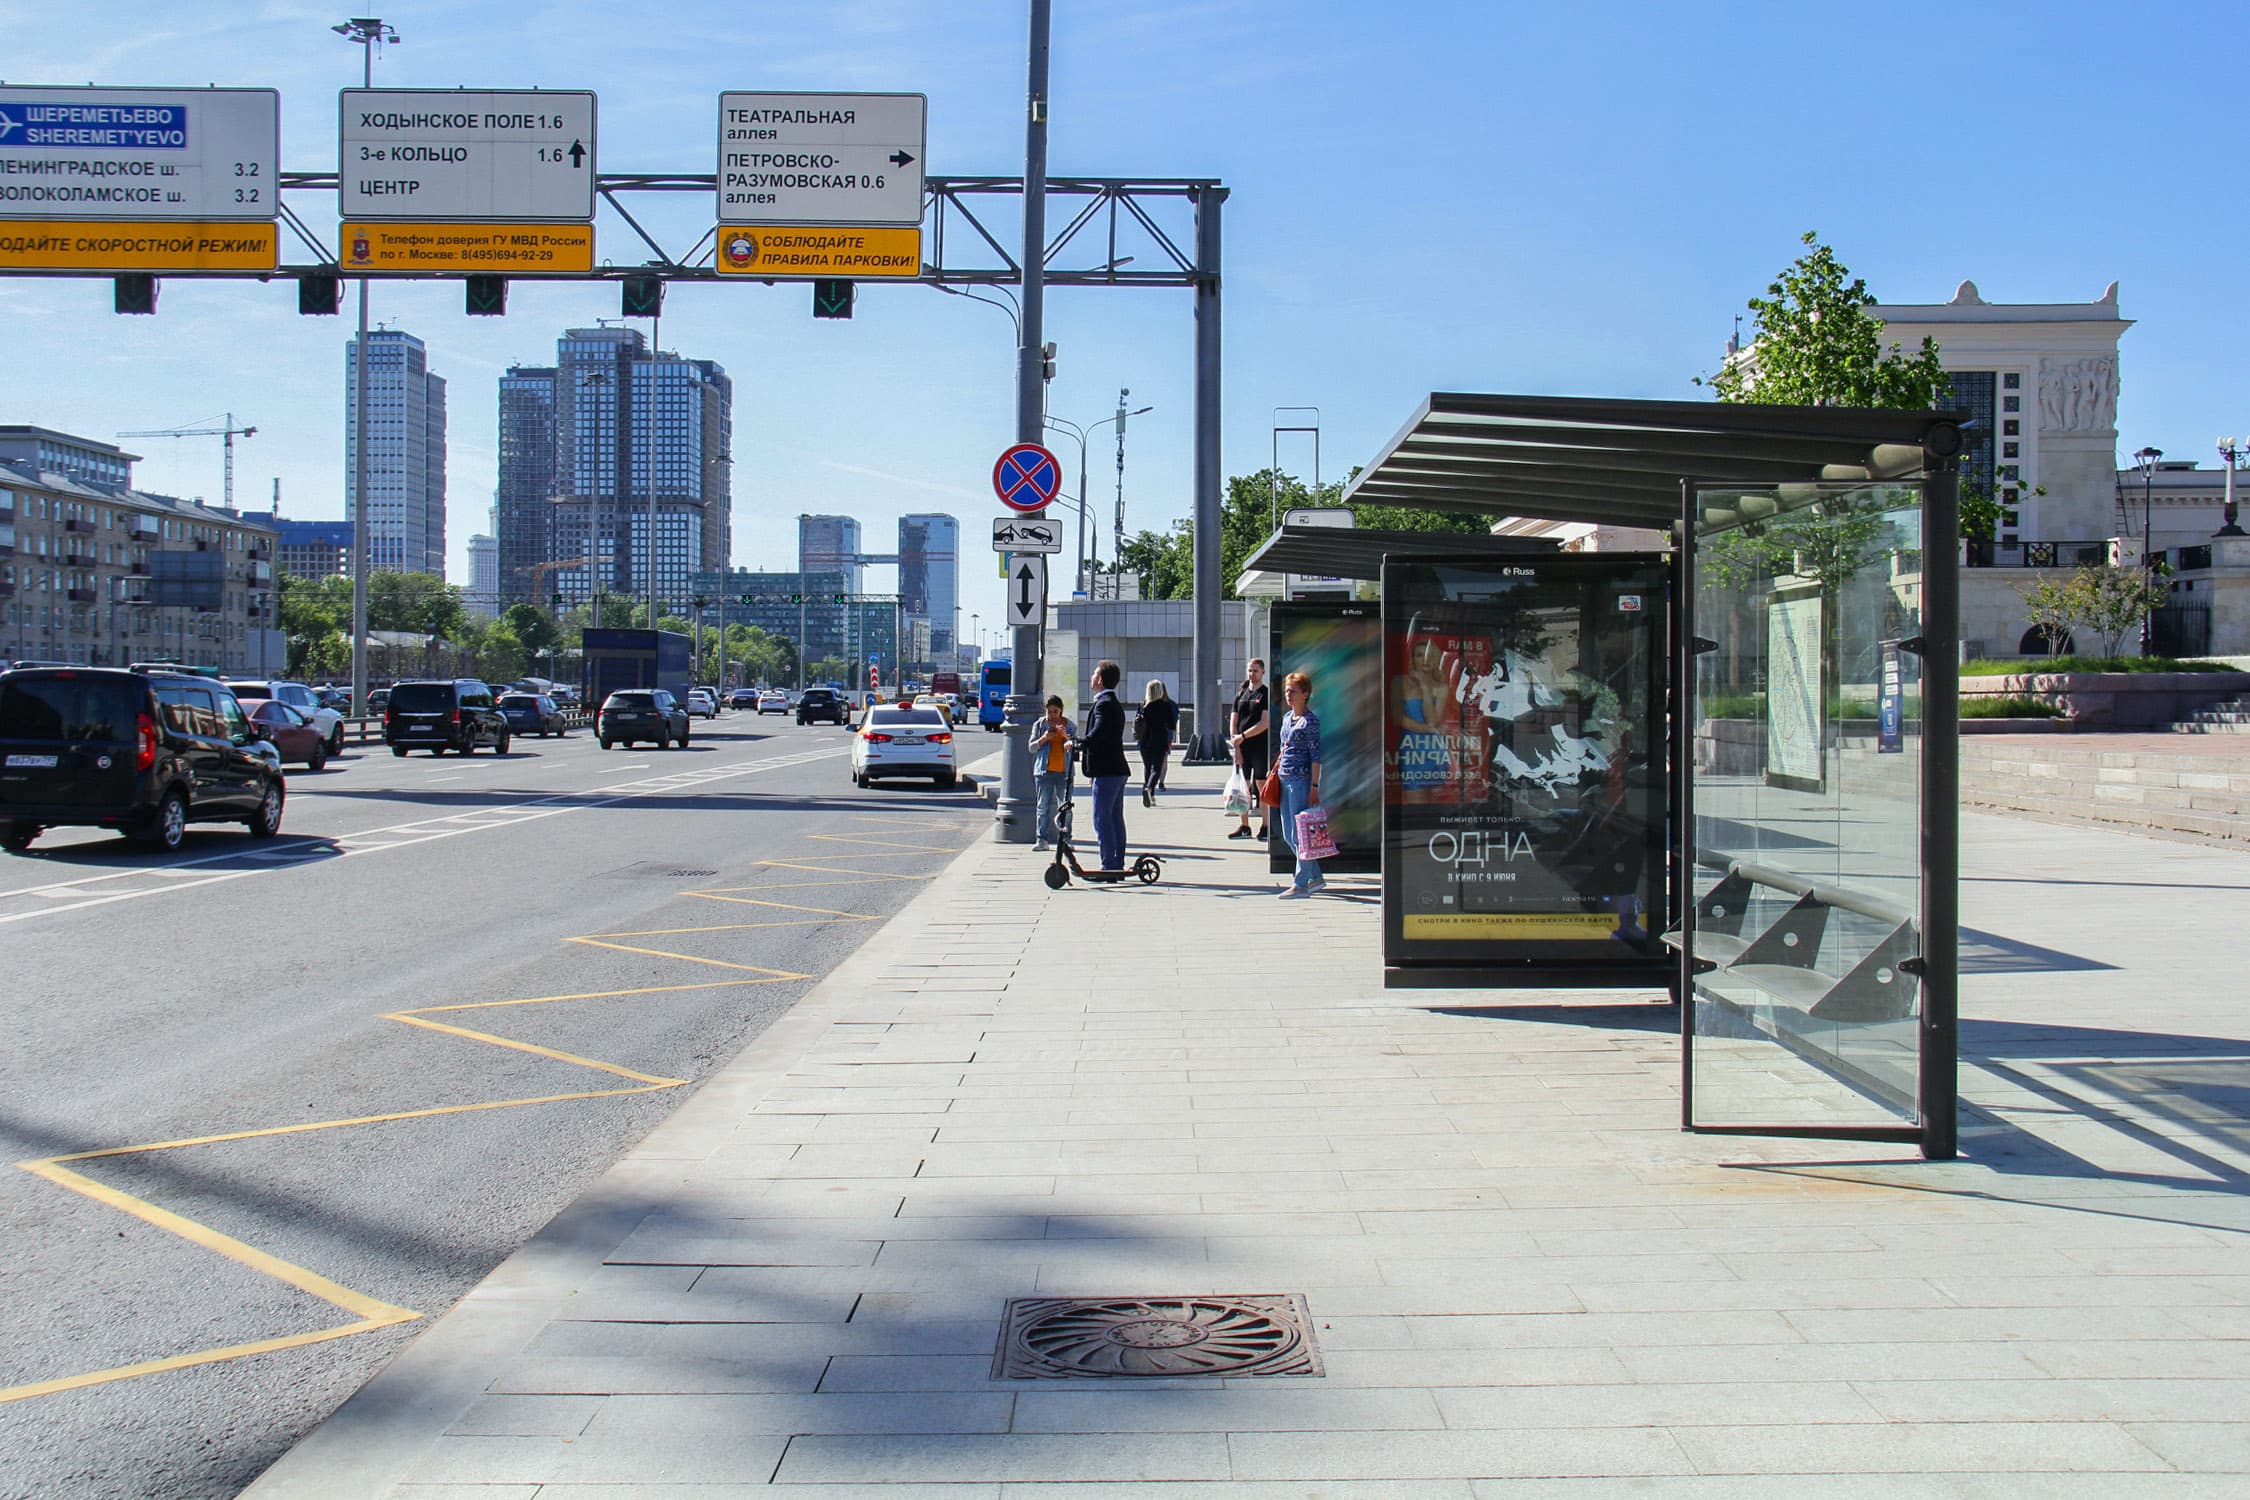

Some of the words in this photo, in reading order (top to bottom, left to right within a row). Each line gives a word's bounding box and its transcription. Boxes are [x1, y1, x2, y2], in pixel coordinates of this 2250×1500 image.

[26, 106, 173, 124] ШЕРЕМЕТЬЕВО
[360, 112, 479, 130] ХОДЫНСКОЕ
[484, 114, 535, 129] ПОЛЕ
[538, 115, 563, 129] 1.6
[727, 109, 856, 124] ТЕАТРАЛЬНАЯ
[727, 128, 777, 140] аллея
[360, 147, 386, 162] 3-е
[391, 147, 468, 164] КОЛЬЦО
[538, 148, 563, 162] 1.6
[727, 153, 840, 168] ПЕТРОВСКО-
[234, 162, 259, 177] 3.2
[360, 180, 420, 197] ЦЕНТР
[726, 173, 856, 189] РАЗУМОВСКАЯ
[861, 175, 885, 189] 0.6
[234, 189, 259, 203] 3.2
[726, 192, 776, 204] аллея
[76, 236, 195, 252] СКОРОСТНОЙ
[198, 239, 267, 253] РЕЖИМ!
[380, 233, 433, 247] Телефон
[436, 236, 489, 247] доверия
[493, 235, 508, 246] ГУ
[511, 235, 538, 248] МВД
[542, 235, 586, 246] России
[762, 234, 865, 250] СОБЛЮДАЙТЕ
[380, 251, 396, 260] по
[409, 250, 458, 260] Москве:
[762, 253, 829, 266] ПРАВИЛА
[833, 254, 914, 267] ПАРКОВКИ!
[1512, 567, 1535, 576] Russ
[1428, 831, 1536, 869] ОДНА
[1455, 872, 1477, 881] КИНО
[1493, 872, 1516, 881] ИЮНЯ
